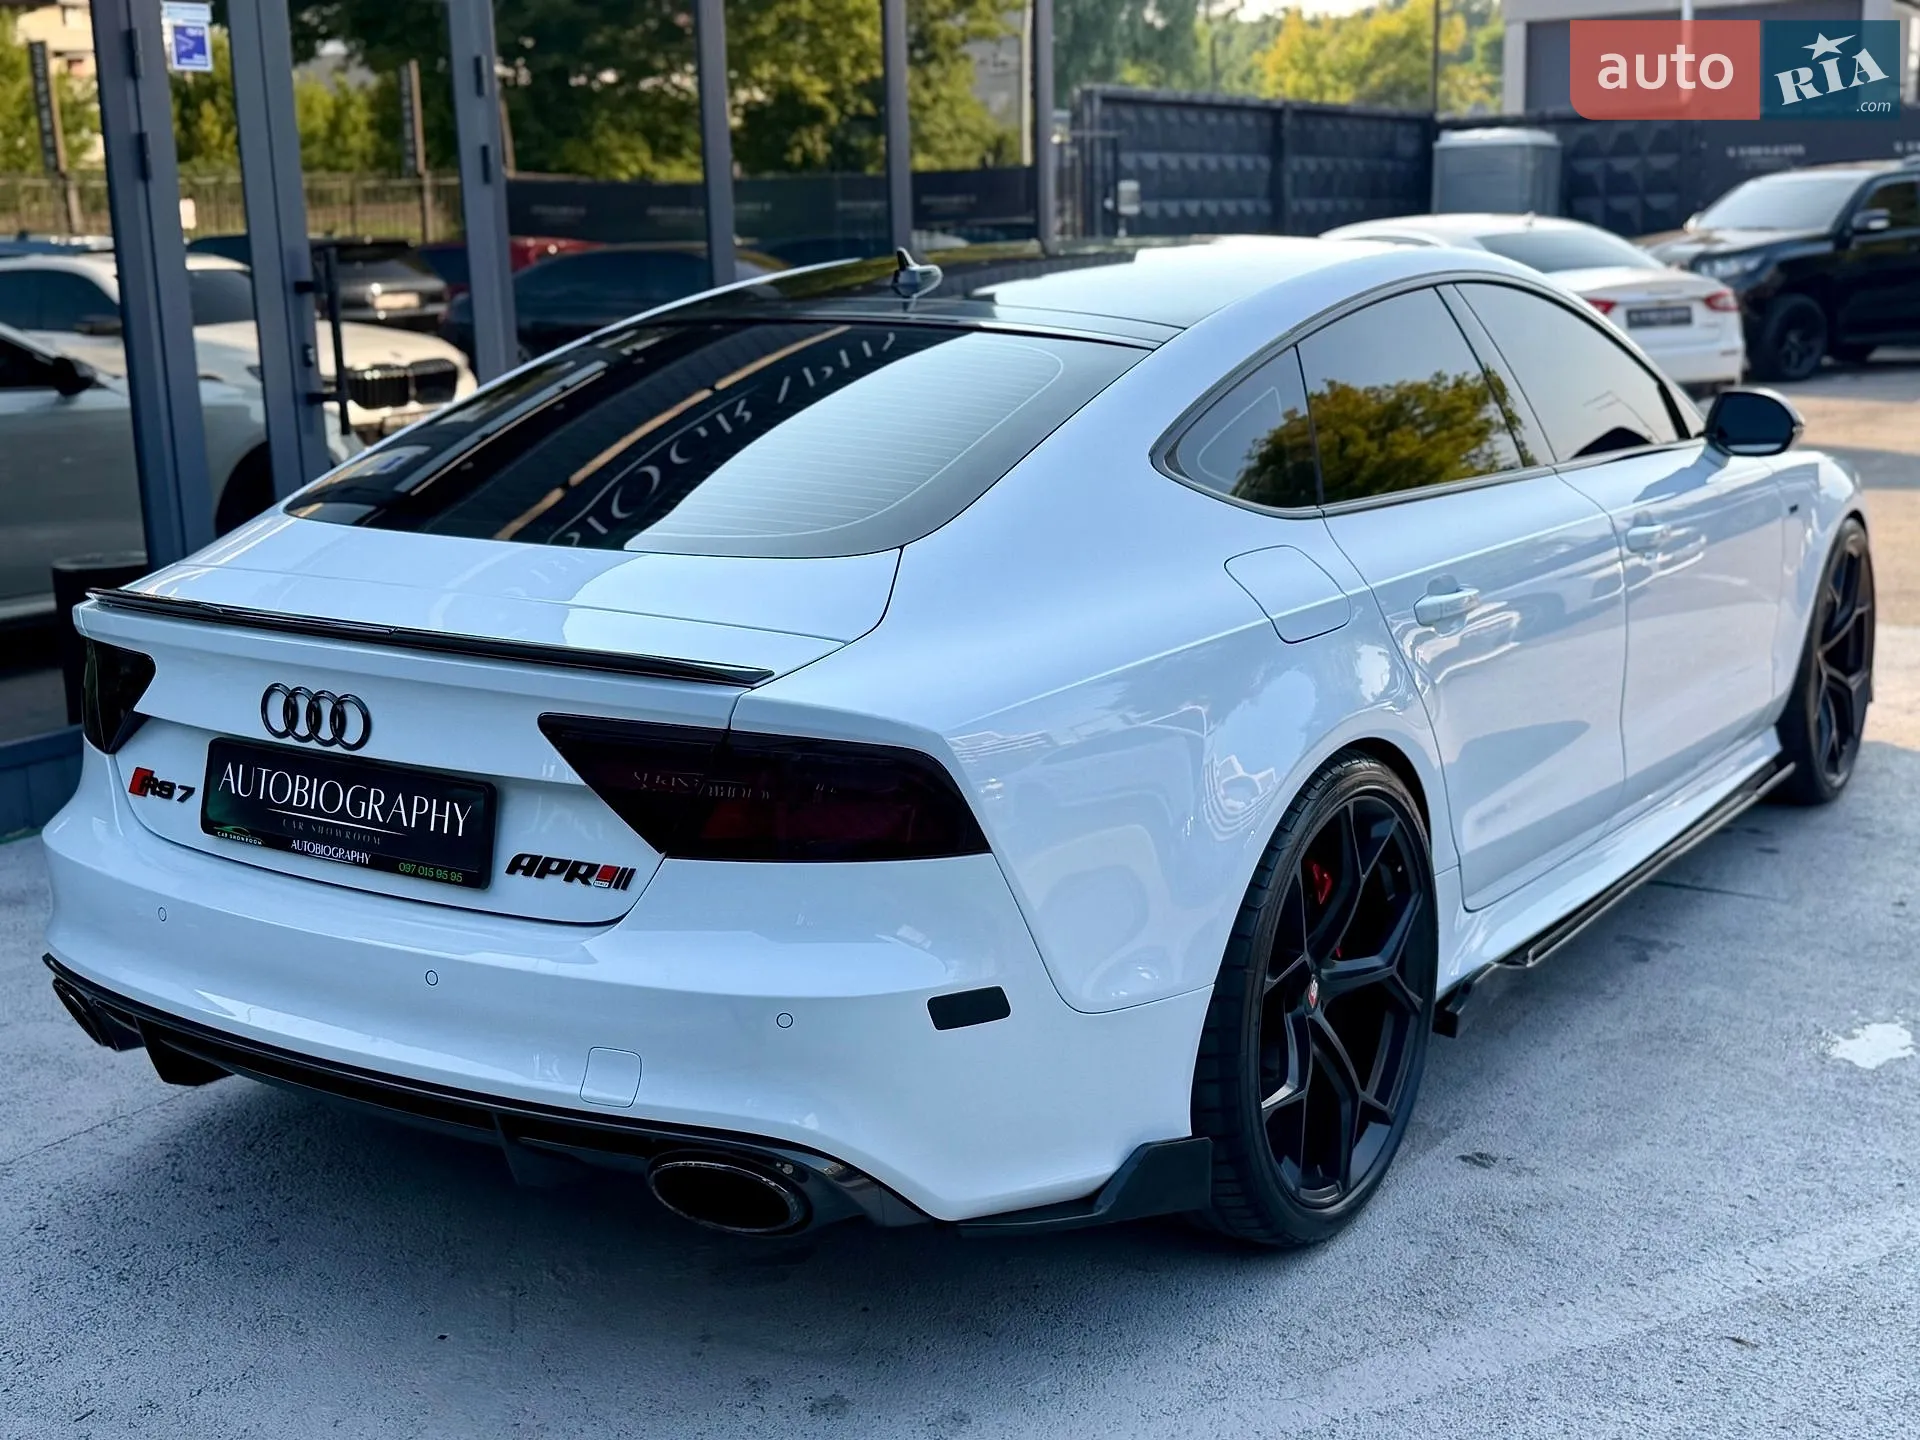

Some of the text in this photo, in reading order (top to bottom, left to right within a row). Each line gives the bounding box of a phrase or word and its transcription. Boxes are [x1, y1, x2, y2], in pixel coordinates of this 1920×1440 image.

[218, 761, 472, 837] AUTOBIOGRAPHY
[282, 818, 382, 846] CAR SHOWROOM
[290, 839, 371, 865] AUTOBIOGRAPHY
[398, 862, 463, 883] 097 015 95 95
